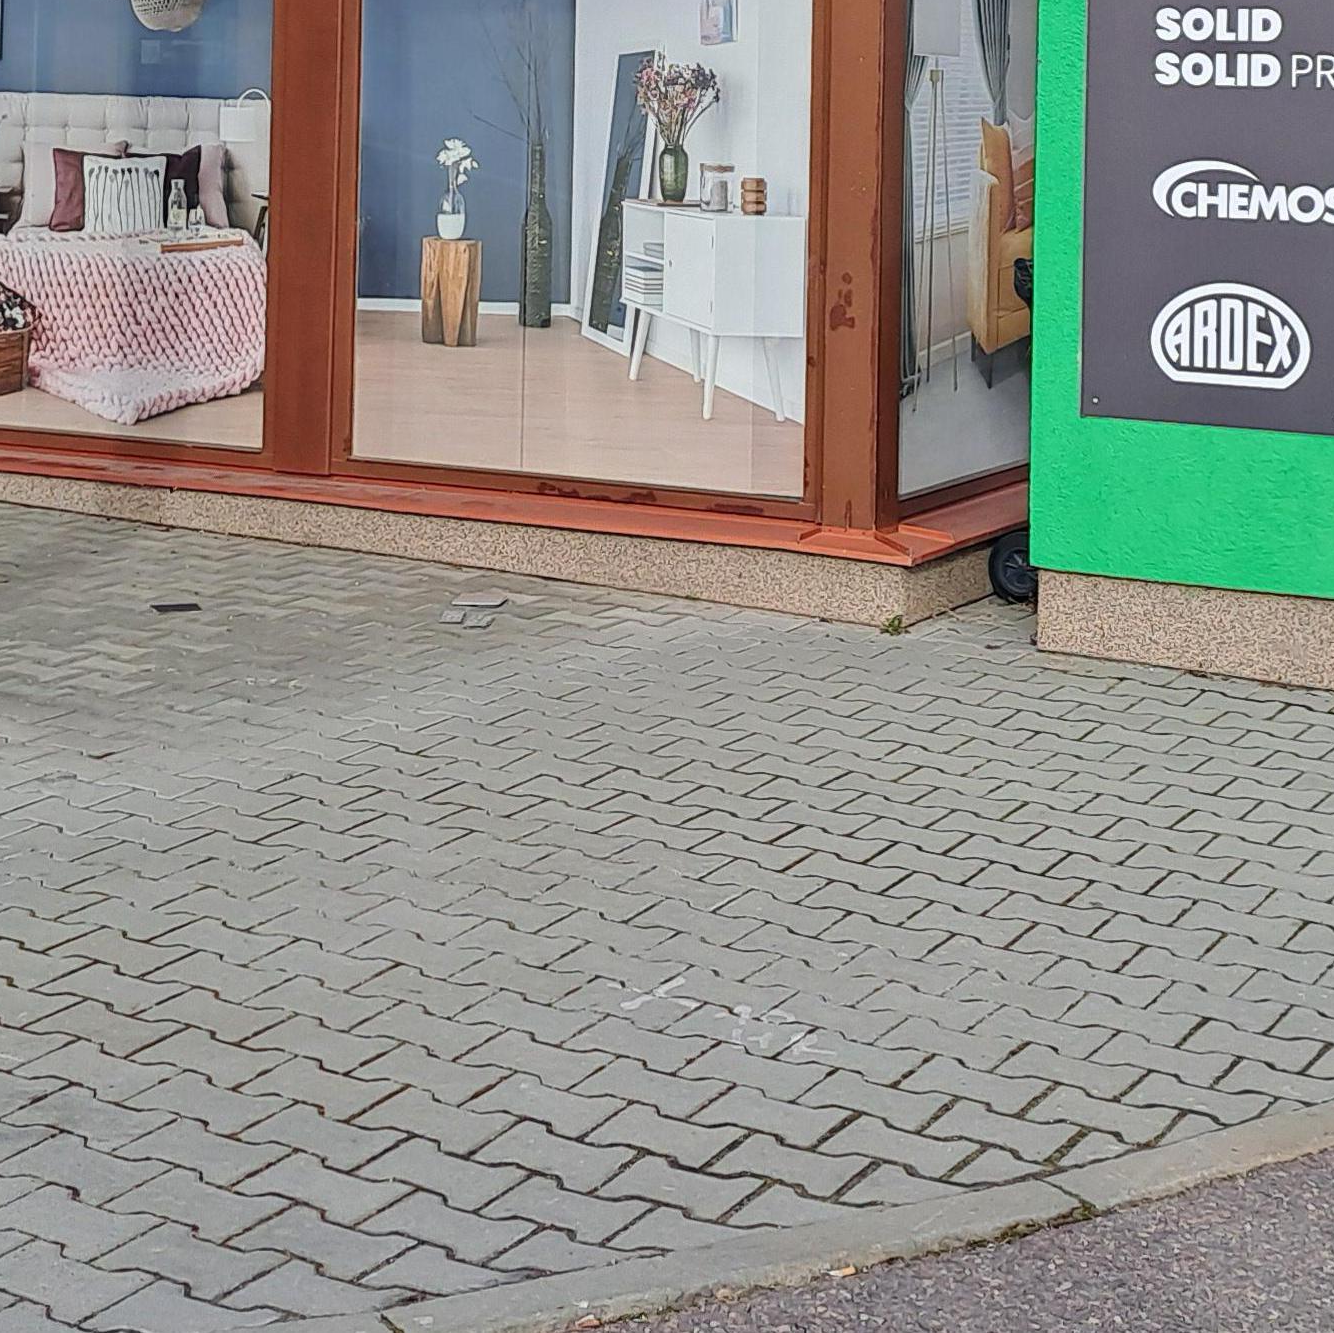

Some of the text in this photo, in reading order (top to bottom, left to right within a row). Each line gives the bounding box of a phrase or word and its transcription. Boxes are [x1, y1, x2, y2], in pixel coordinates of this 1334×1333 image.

[1155, 7, 1282, 42] SOLID
[1154, 52, 1281, 87] SOLID
[1165, 298, 1292, 373] ARDEX
